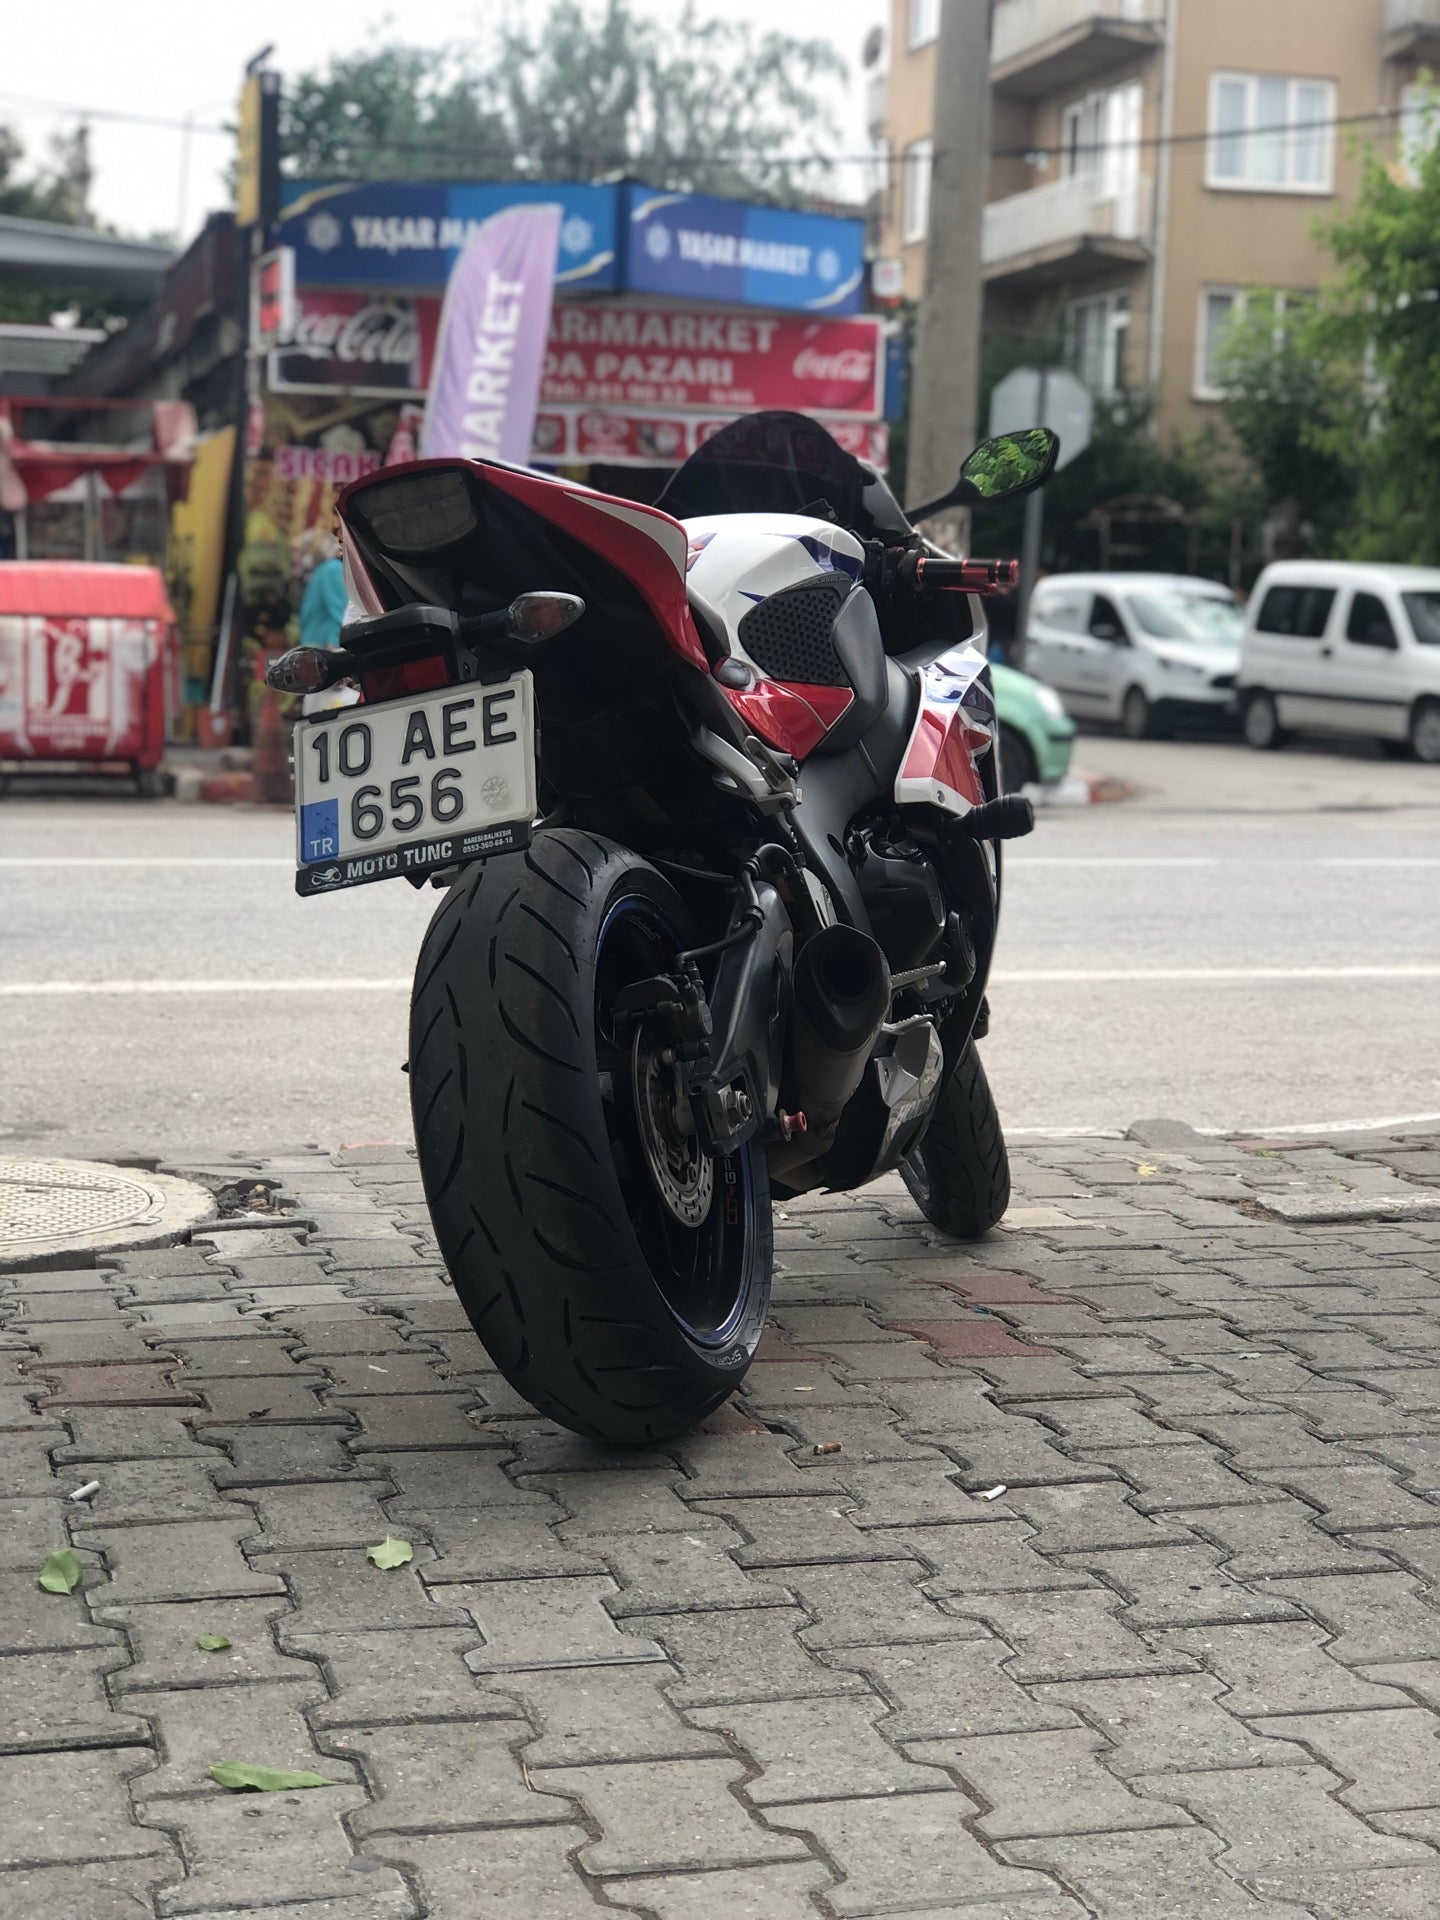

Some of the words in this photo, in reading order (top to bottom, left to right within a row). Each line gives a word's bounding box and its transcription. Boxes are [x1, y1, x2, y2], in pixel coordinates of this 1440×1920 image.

[352, 216, 435, 255] YAŞAR
[739, 238, 811, 276] MARKET
[595, 353, 734, 386] PAZARI
[312, 723, 372, 783] 10
[401, 689, 517, 765] AEE
[352, 768, 464, 840] 656
[310, 837, 333, 857] TR
[347, 853, 398, 879] MOTO
[403, 841, 453, 867] TUNC
